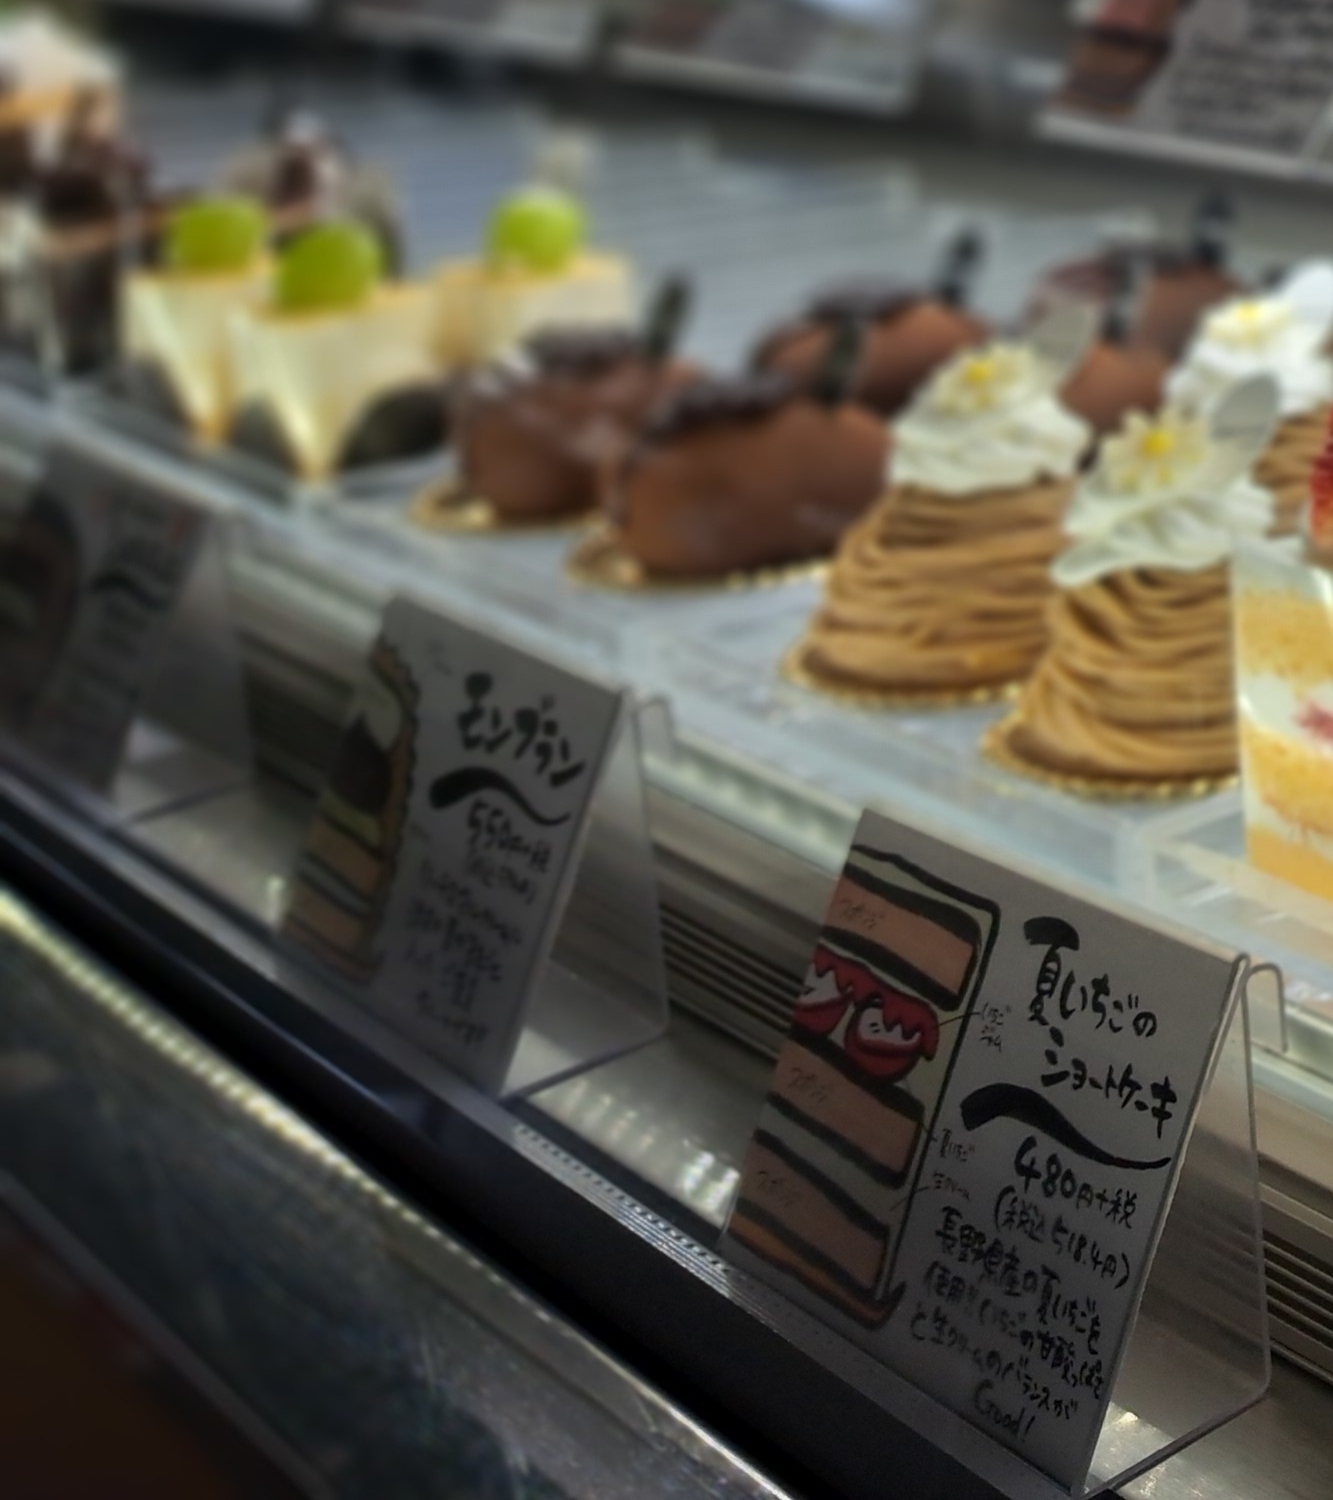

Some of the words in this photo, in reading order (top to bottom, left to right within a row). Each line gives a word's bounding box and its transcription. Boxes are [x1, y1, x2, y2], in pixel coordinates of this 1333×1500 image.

[1024, 916, 1157, 1037] 夏いちごの
[1040, 1026, 1178, 1139] ショートケーキ
[1014, 1136, 1138, 1229] 480円+税
